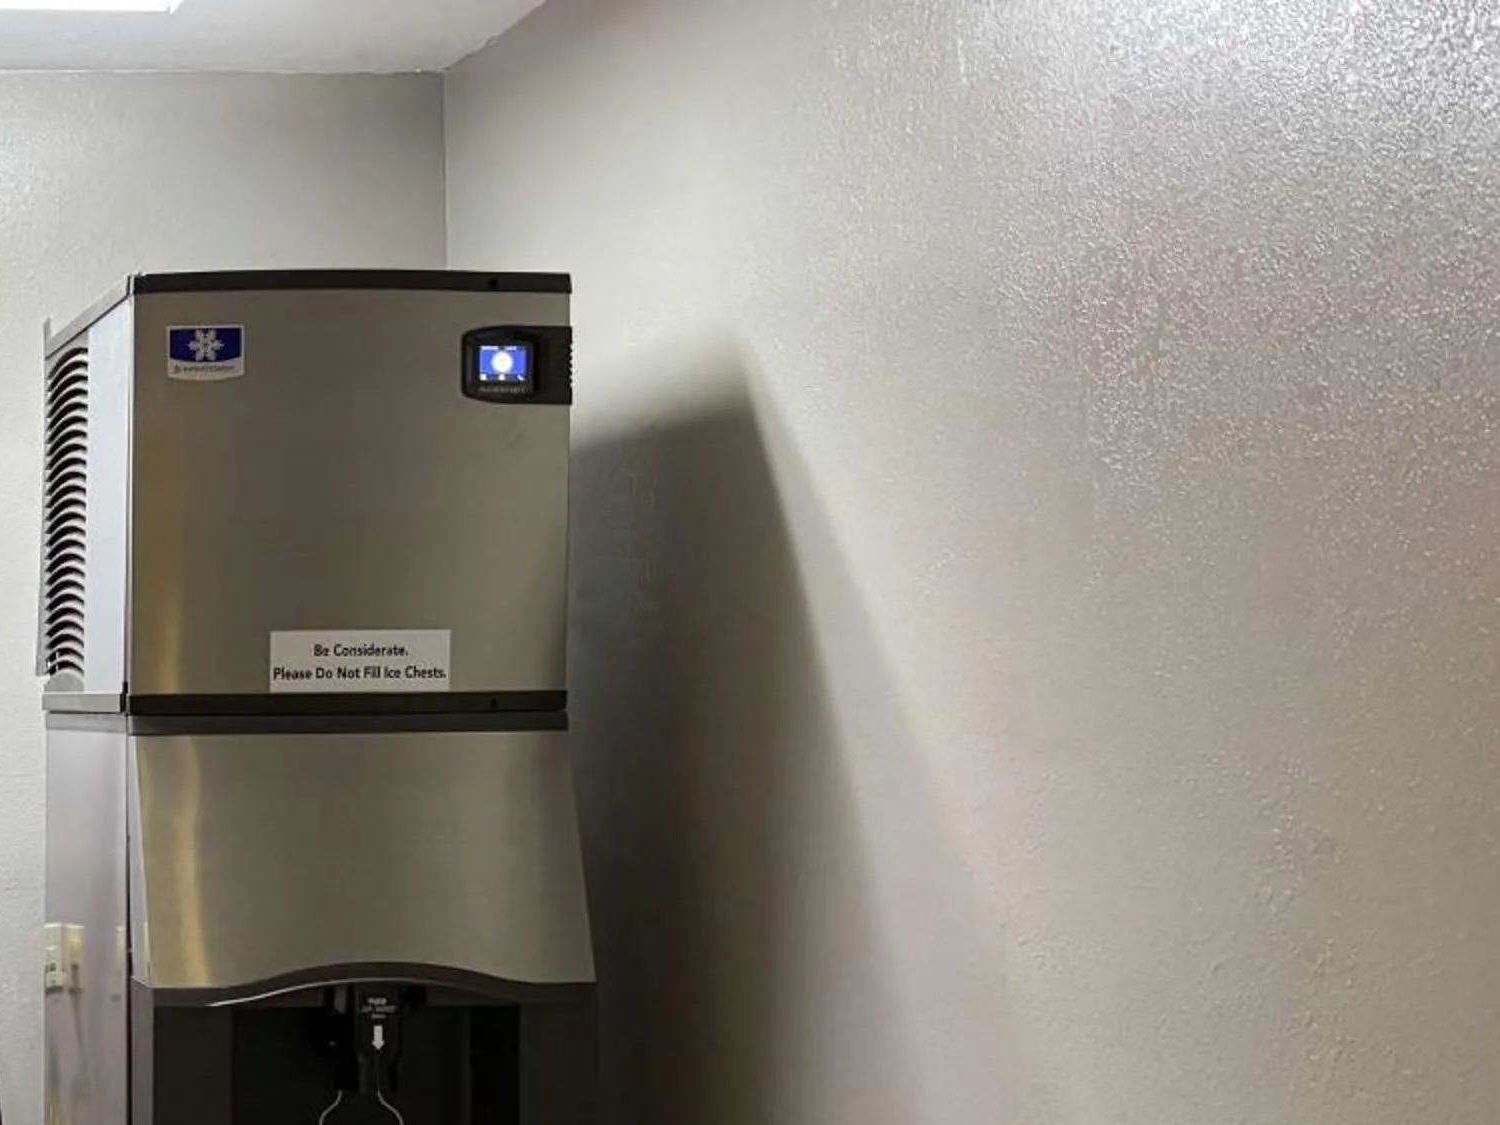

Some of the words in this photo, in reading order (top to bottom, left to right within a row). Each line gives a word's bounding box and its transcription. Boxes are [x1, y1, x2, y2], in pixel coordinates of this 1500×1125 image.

[313, 643, 329, 657] Be
[333, 643, 409, 657] Considerate.
[273, 667, 312, 681] Please
[316, 667, 333, 680] Do
[337, 667, 360, 680] Not
[364, 666, 381, 679] Fill
[384, 666, 401, 679] Ice
[405, 665, 447, 679] Chests.
